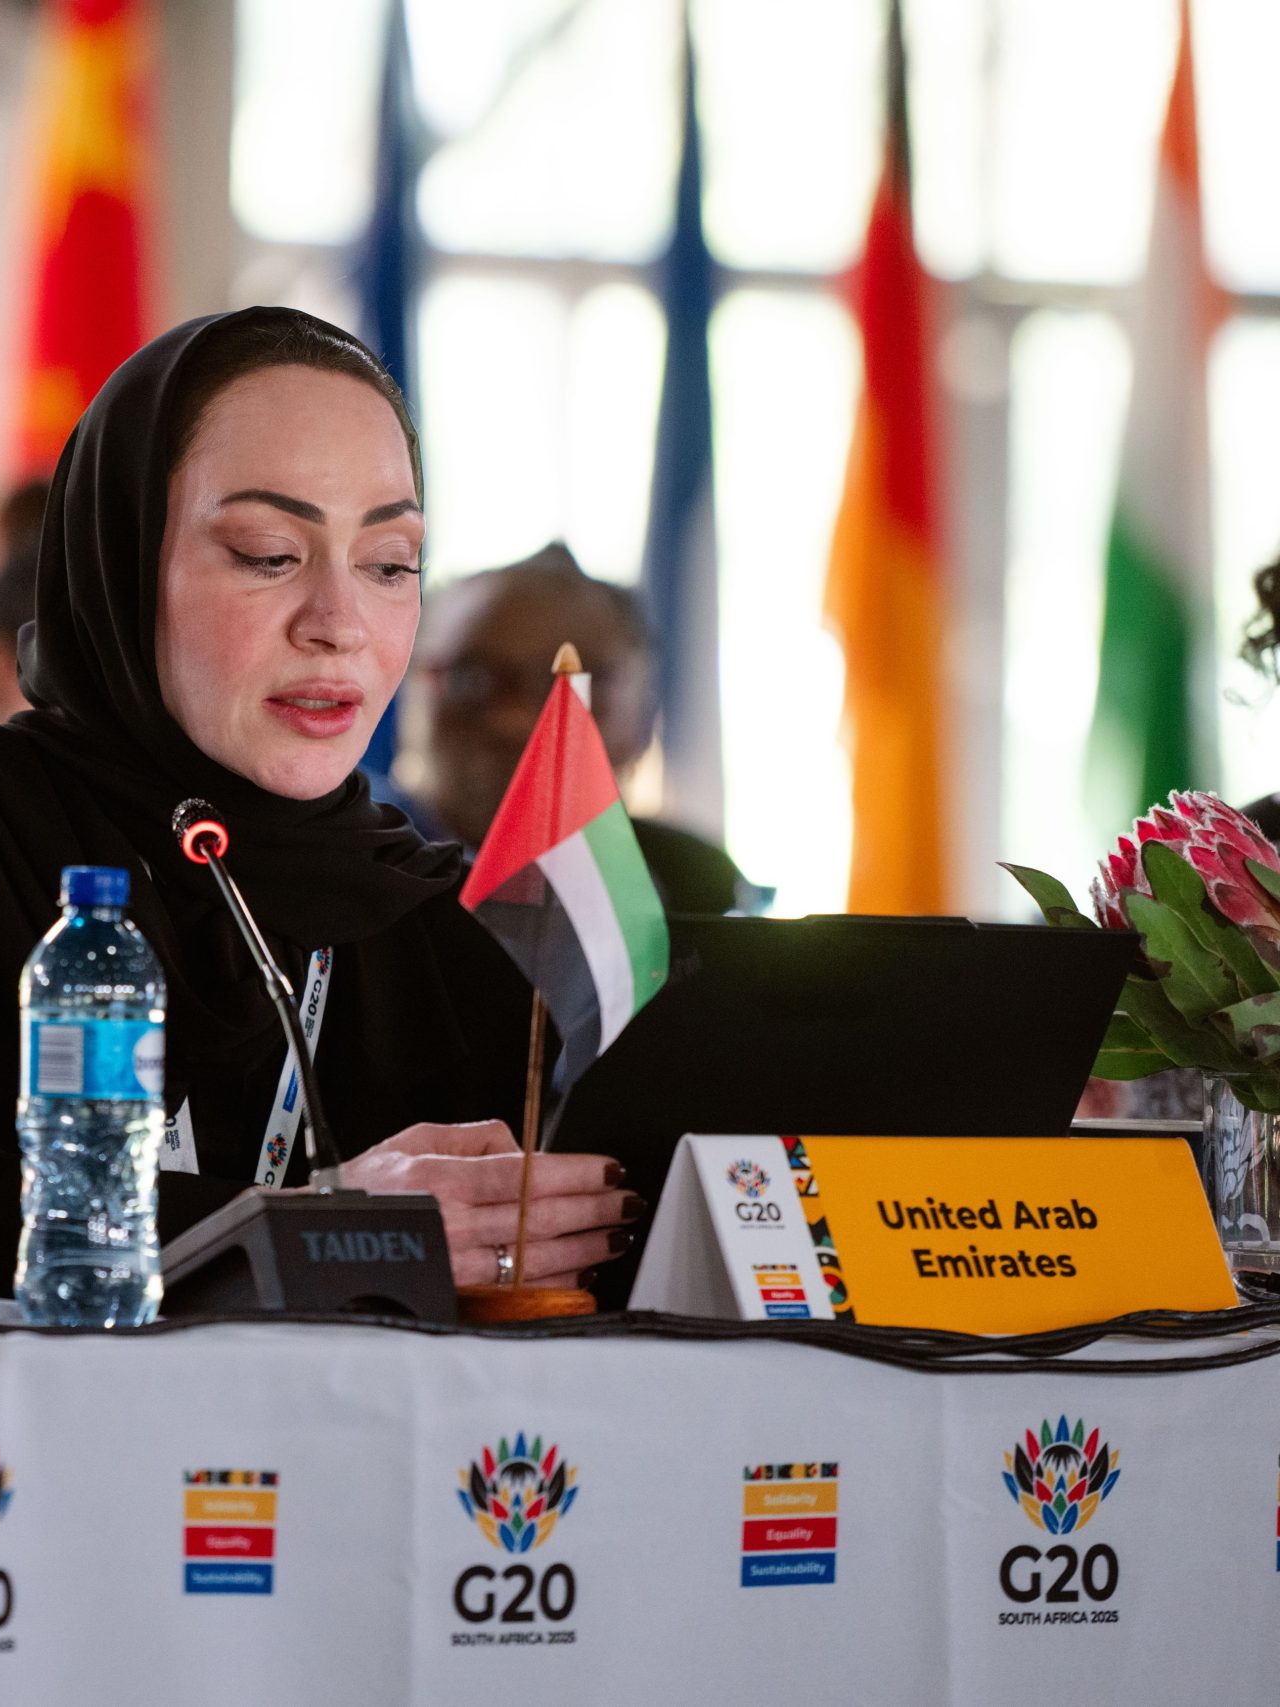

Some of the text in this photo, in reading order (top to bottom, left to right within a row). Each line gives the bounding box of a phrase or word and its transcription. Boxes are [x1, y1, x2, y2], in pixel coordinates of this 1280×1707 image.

[308, 979, 322, 1016] G20
[735, 1202, 781, 1222] G20
[876, 1197, 1098, 1230] United Arab
[300, 1231, 426, 1261] TAIDEN
[911, 1245, 1077, 1278] Emirates
[766, 1528, 813, 1542] Equality
[750, 1561, 827, 1577] Sustainability
[1000, 1543, 1119, 1603] G20
[454, 1563, 576, 1622] G20
[999, 1610, 1119, 1625] SOUTH AFRICA 2025
[452, 1633, 495, 1646] SOUTH
[500, 1632, 542, 1645] AFRICA
